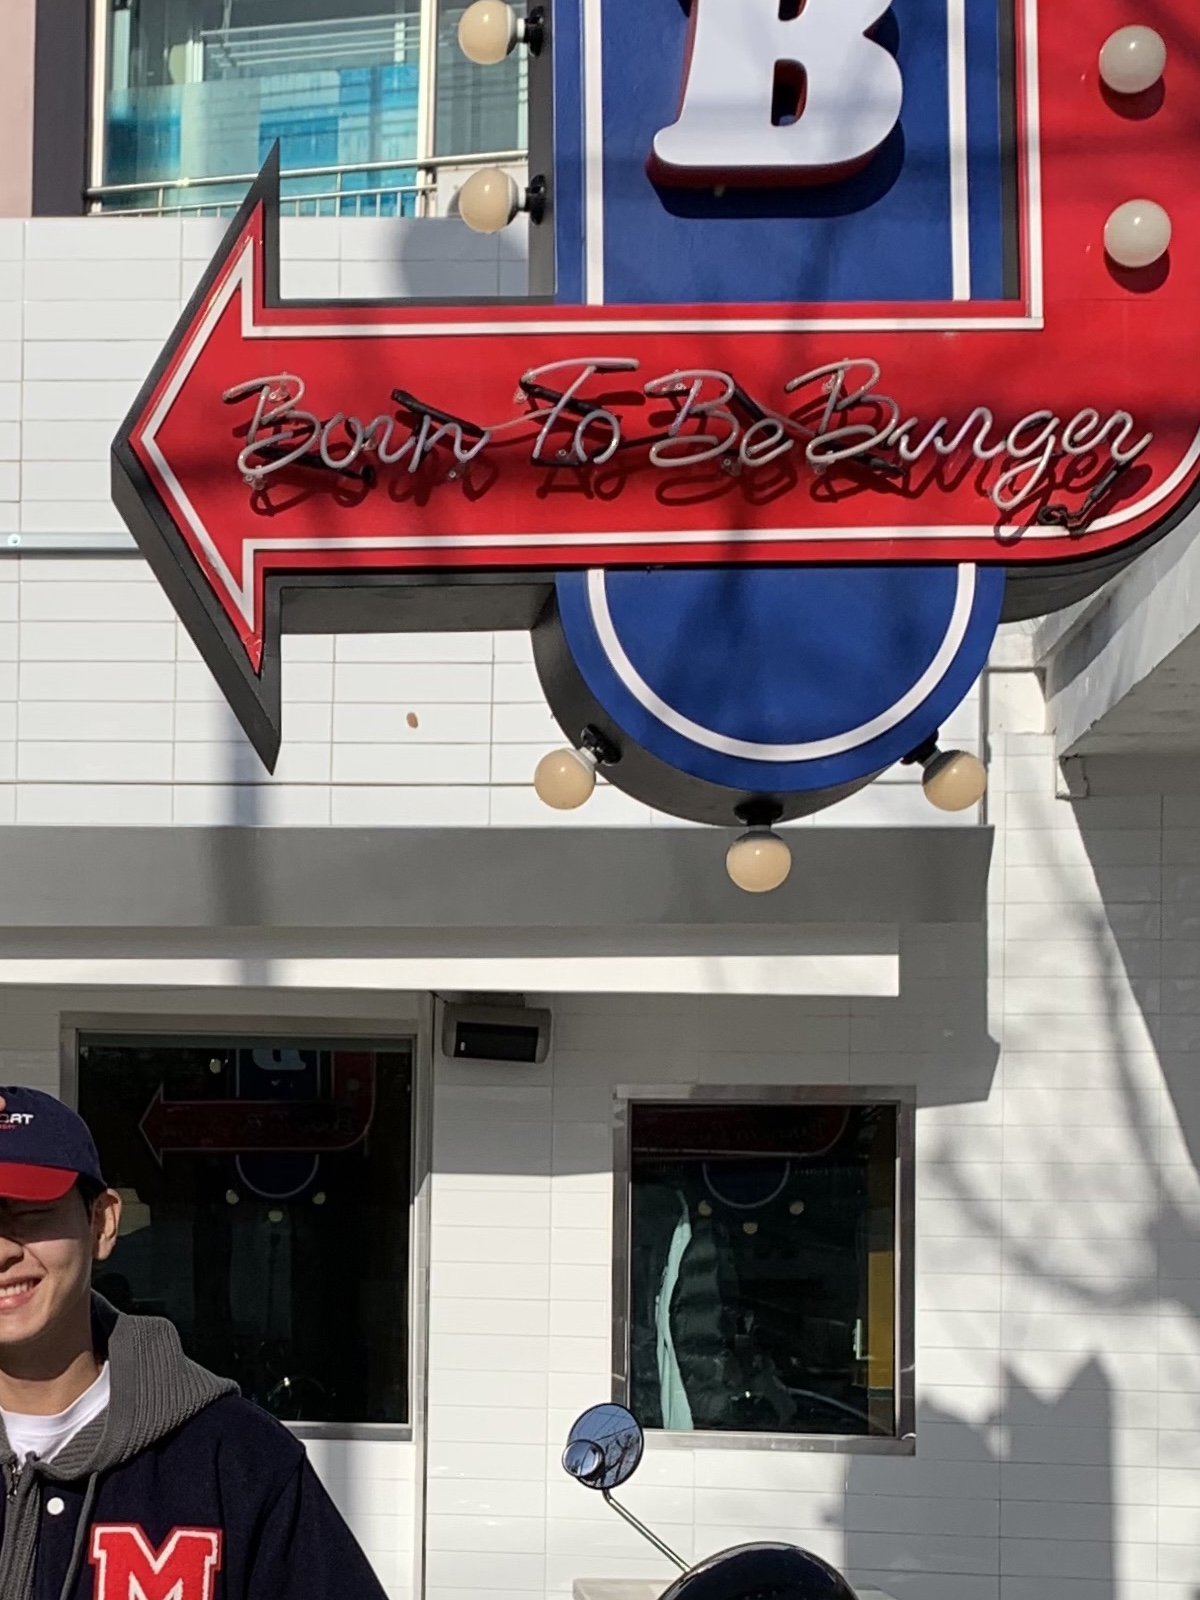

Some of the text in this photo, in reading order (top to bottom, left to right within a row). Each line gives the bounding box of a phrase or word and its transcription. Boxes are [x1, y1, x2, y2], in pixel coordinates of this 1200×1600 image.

[650, 0, 904, 170] B
[222, 357, 1154, 511] Born To Be Burger
